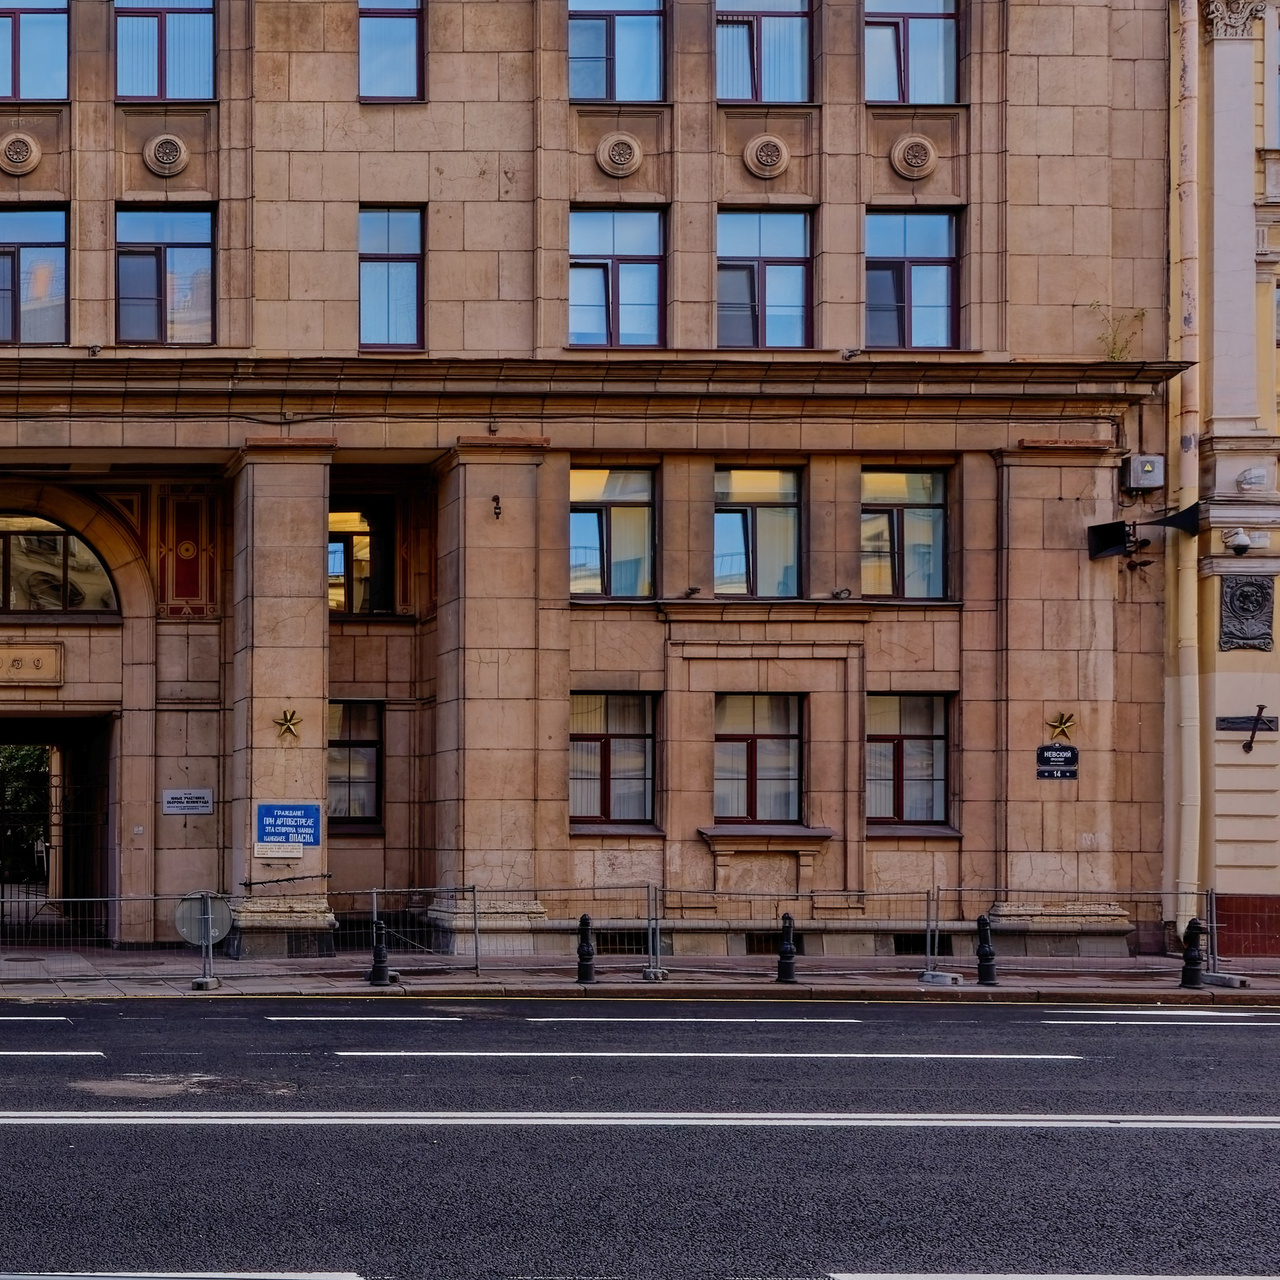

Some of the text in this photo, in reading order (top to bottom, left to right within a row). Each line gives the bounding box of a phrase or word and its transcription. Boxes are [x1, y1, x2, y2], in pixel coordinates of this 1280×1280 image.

[263, 817, 315, 826] ПРИ АРТОБСТРЕЛЕ
[288, 833, 314, 843] ОПАСНА
